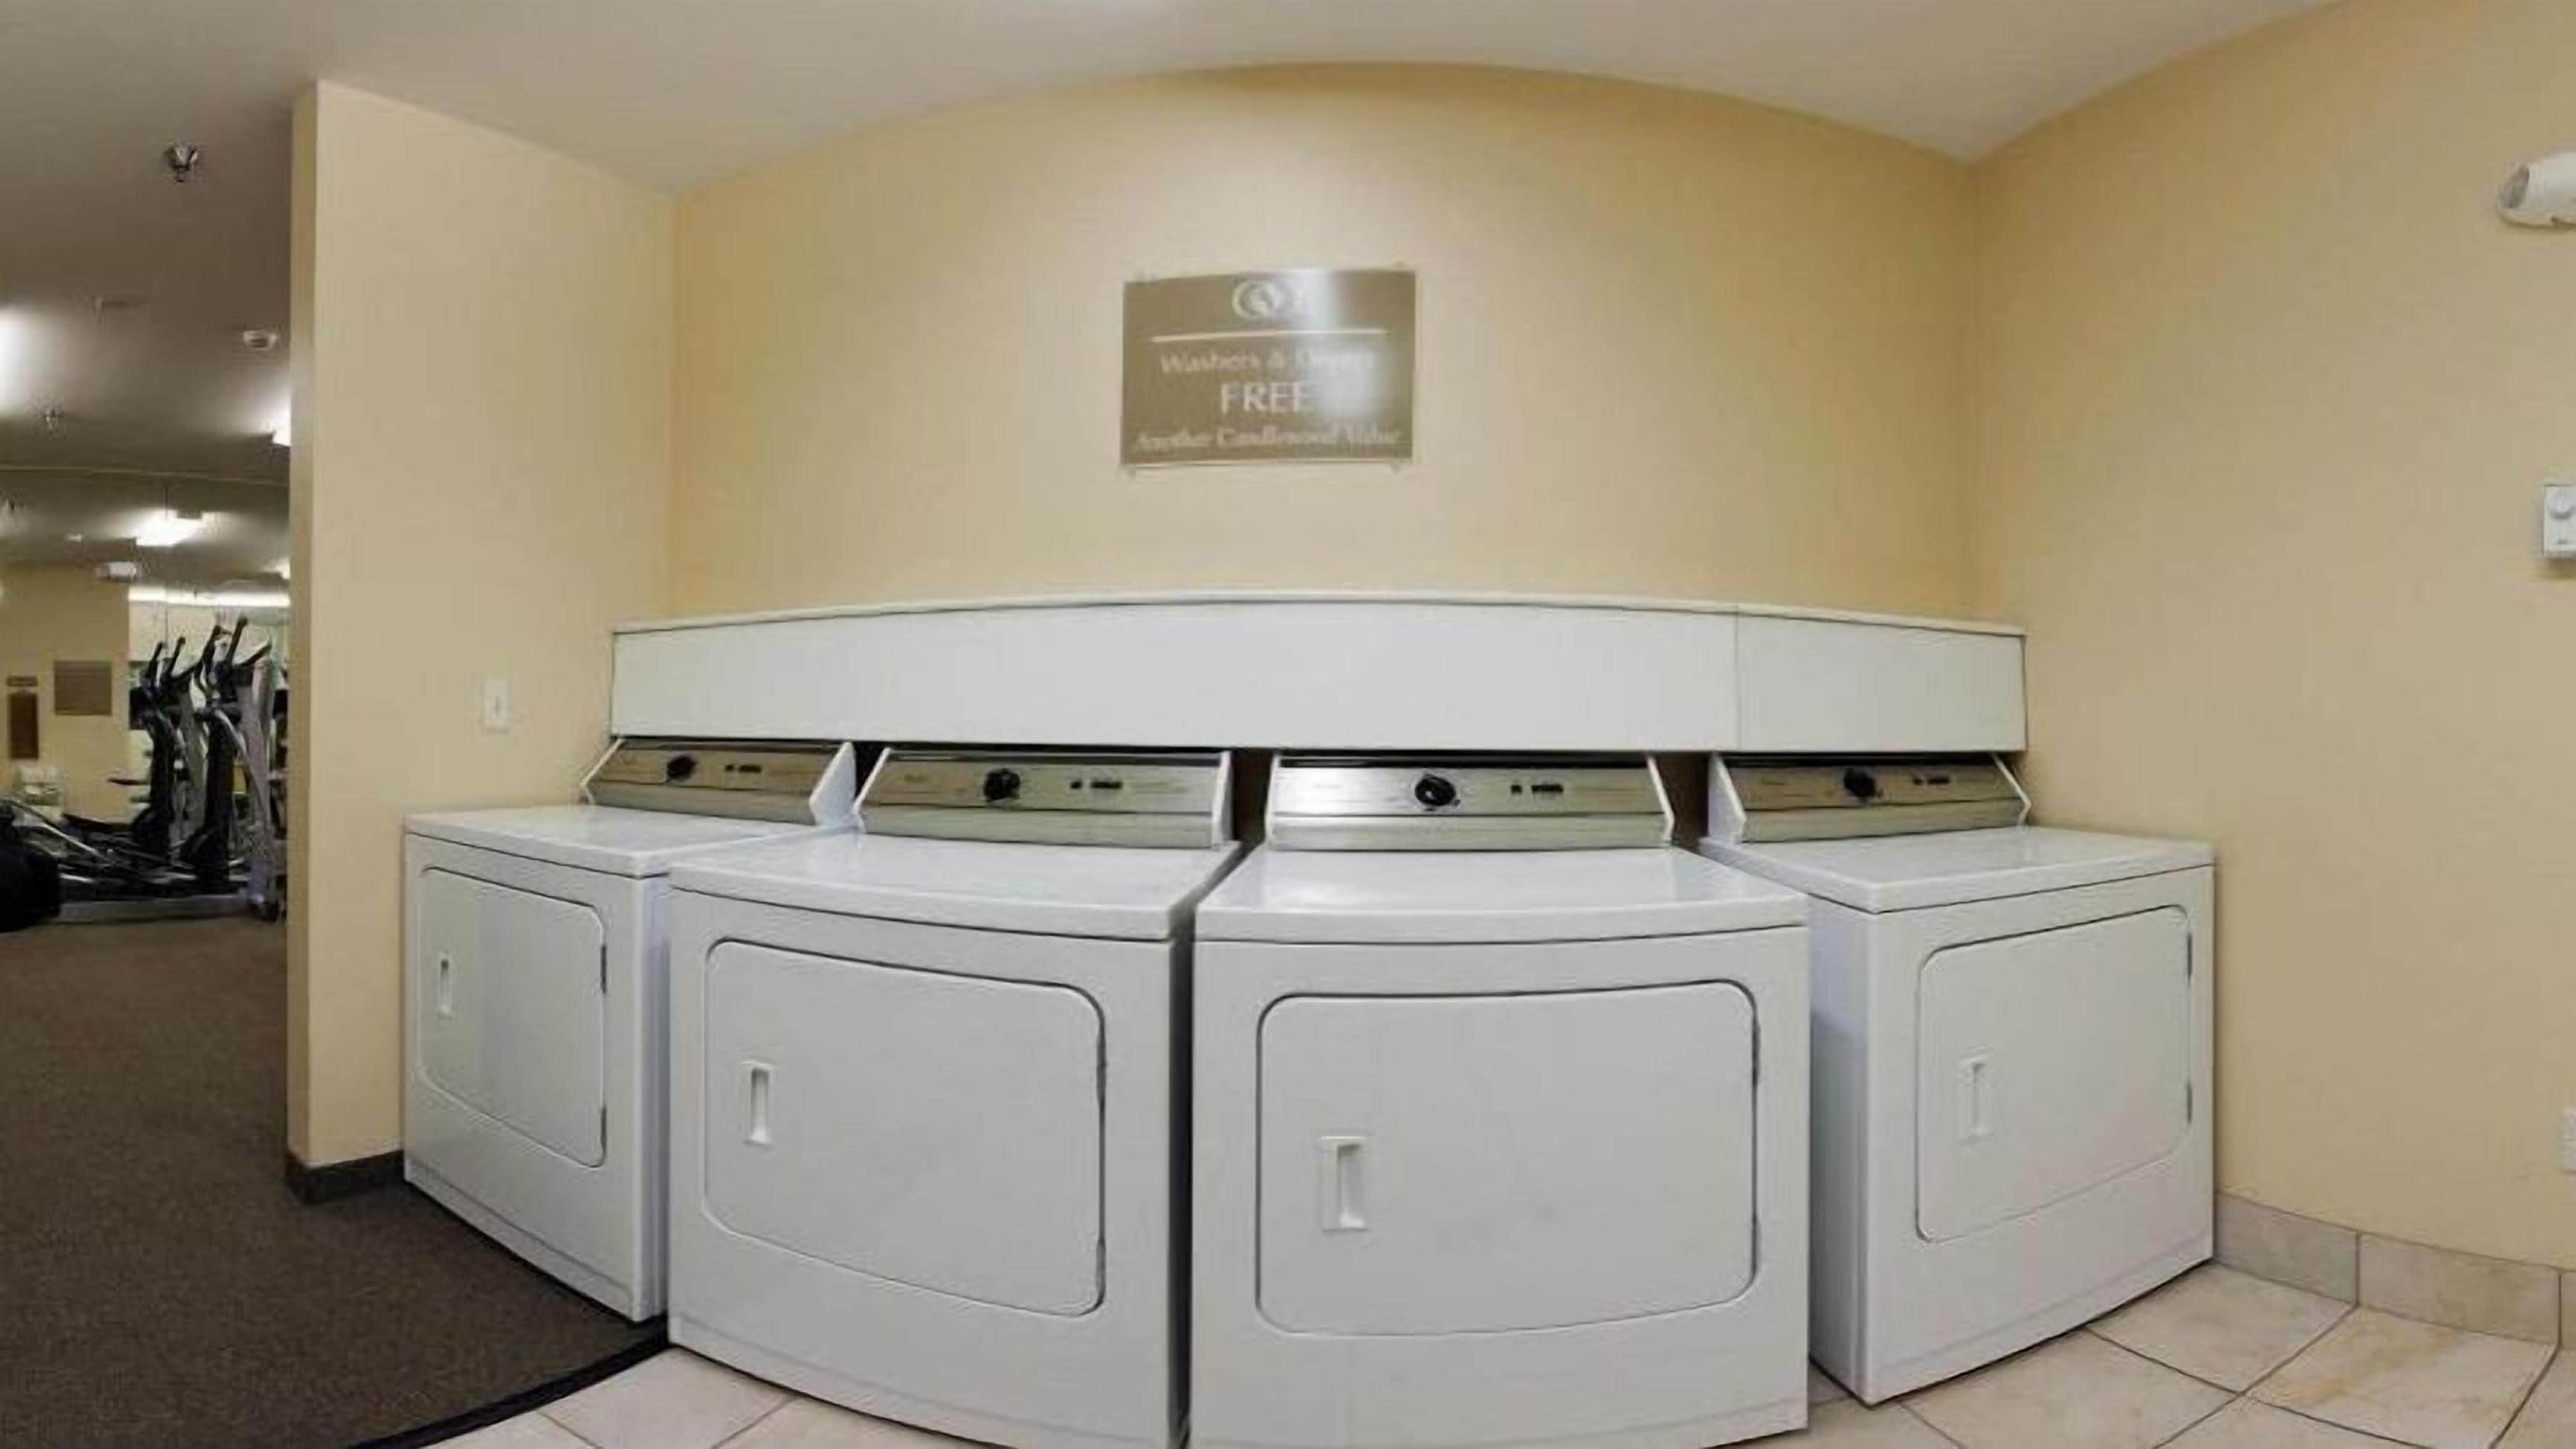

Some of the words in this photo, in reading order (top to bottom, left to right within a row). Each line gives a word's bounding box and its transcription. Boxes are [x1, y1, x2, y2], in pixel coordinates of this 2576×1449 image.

[1159, 351, 1260, 372] Washers
[1266, 349, 1286, 370] &
[1220, 381, 1314, 416] FREE
[1134, 430, 1212, 453] Another
